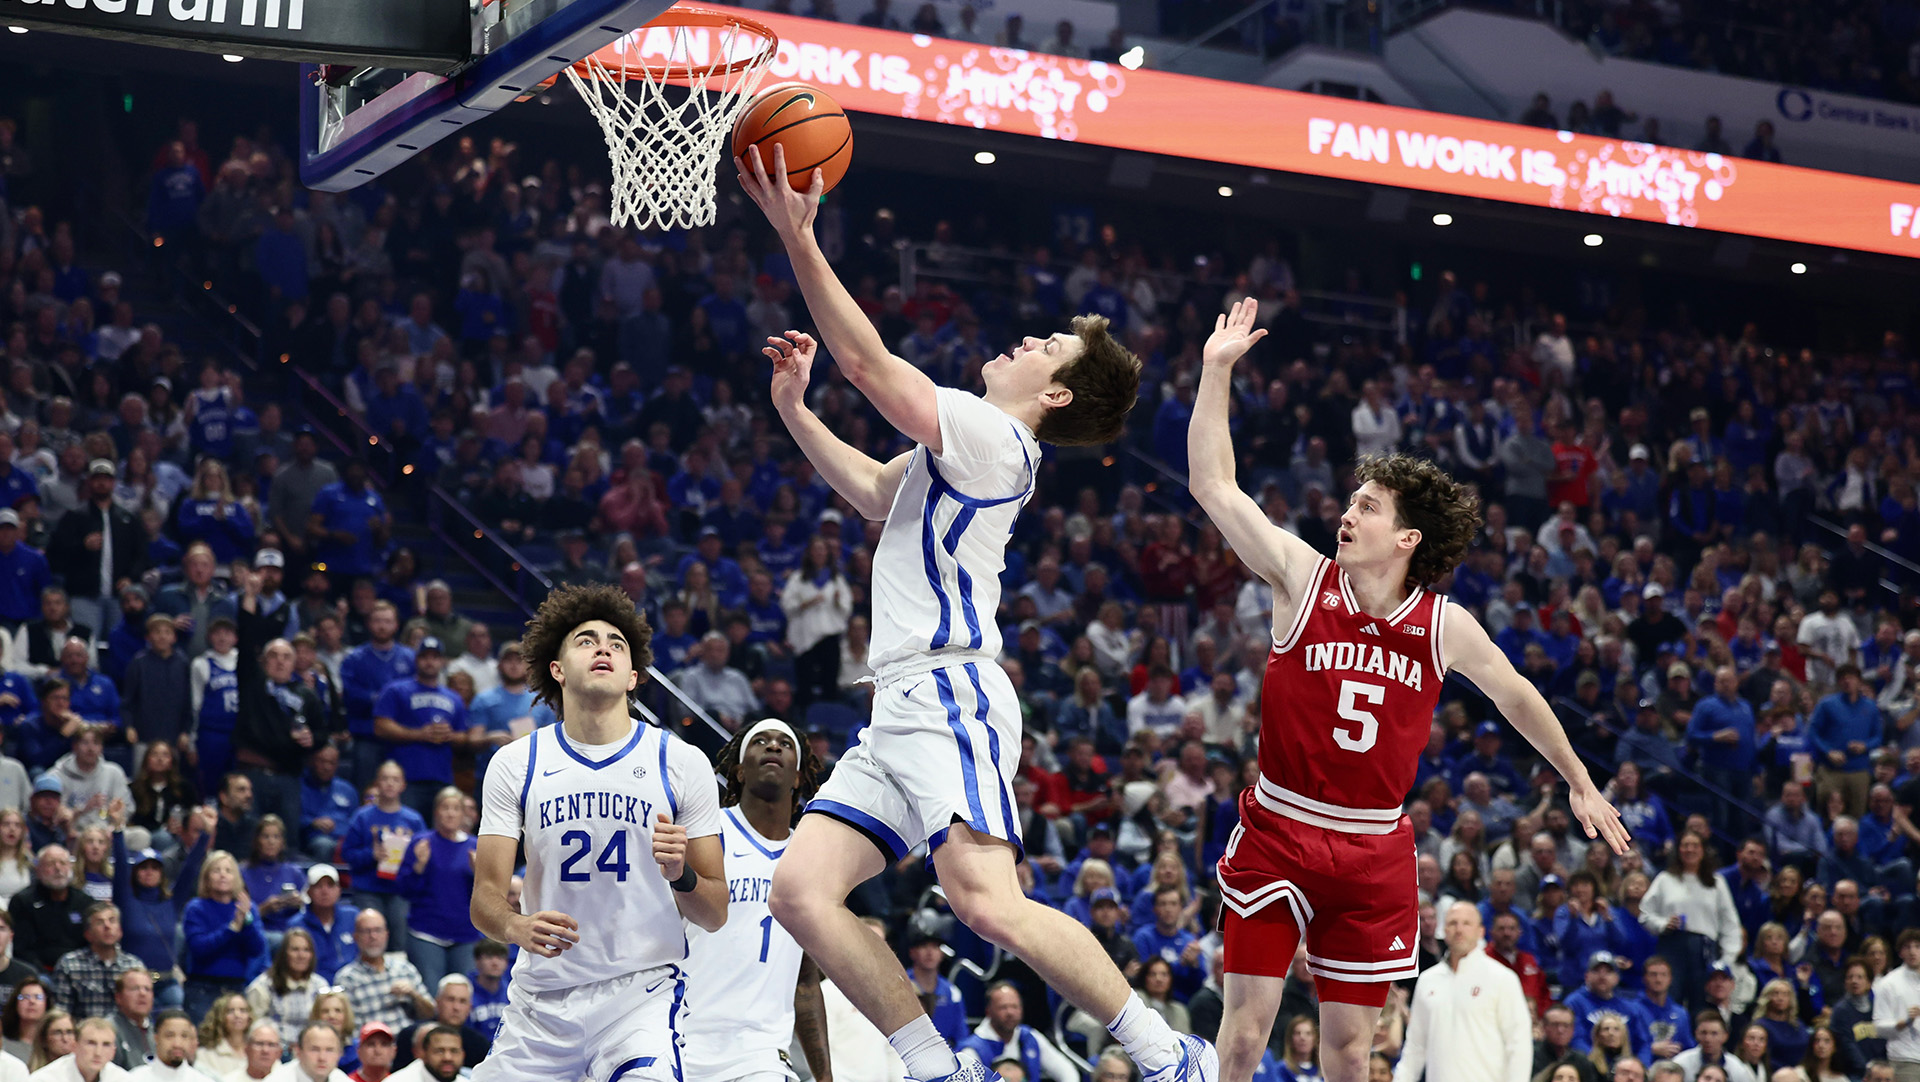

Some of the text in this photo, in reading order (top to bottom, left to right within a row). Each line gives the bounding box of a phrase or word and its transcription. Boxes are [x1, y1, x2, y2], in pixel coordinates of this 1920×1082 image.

[613, 26, 710, 66] FAN
[719, 30, 862, 88] WORK
[1308, 117, 1390, 164] FAN
[1395, 130, 1517, 182] WORK
[1305, 642, 1422, 692] INDIANA
[1332, 679, 1386, 753] 5
[540, 791, 652, 829] KENTUCKY
[560, 830, 631, 882] 24
[759, 915, 773, 963] 1
